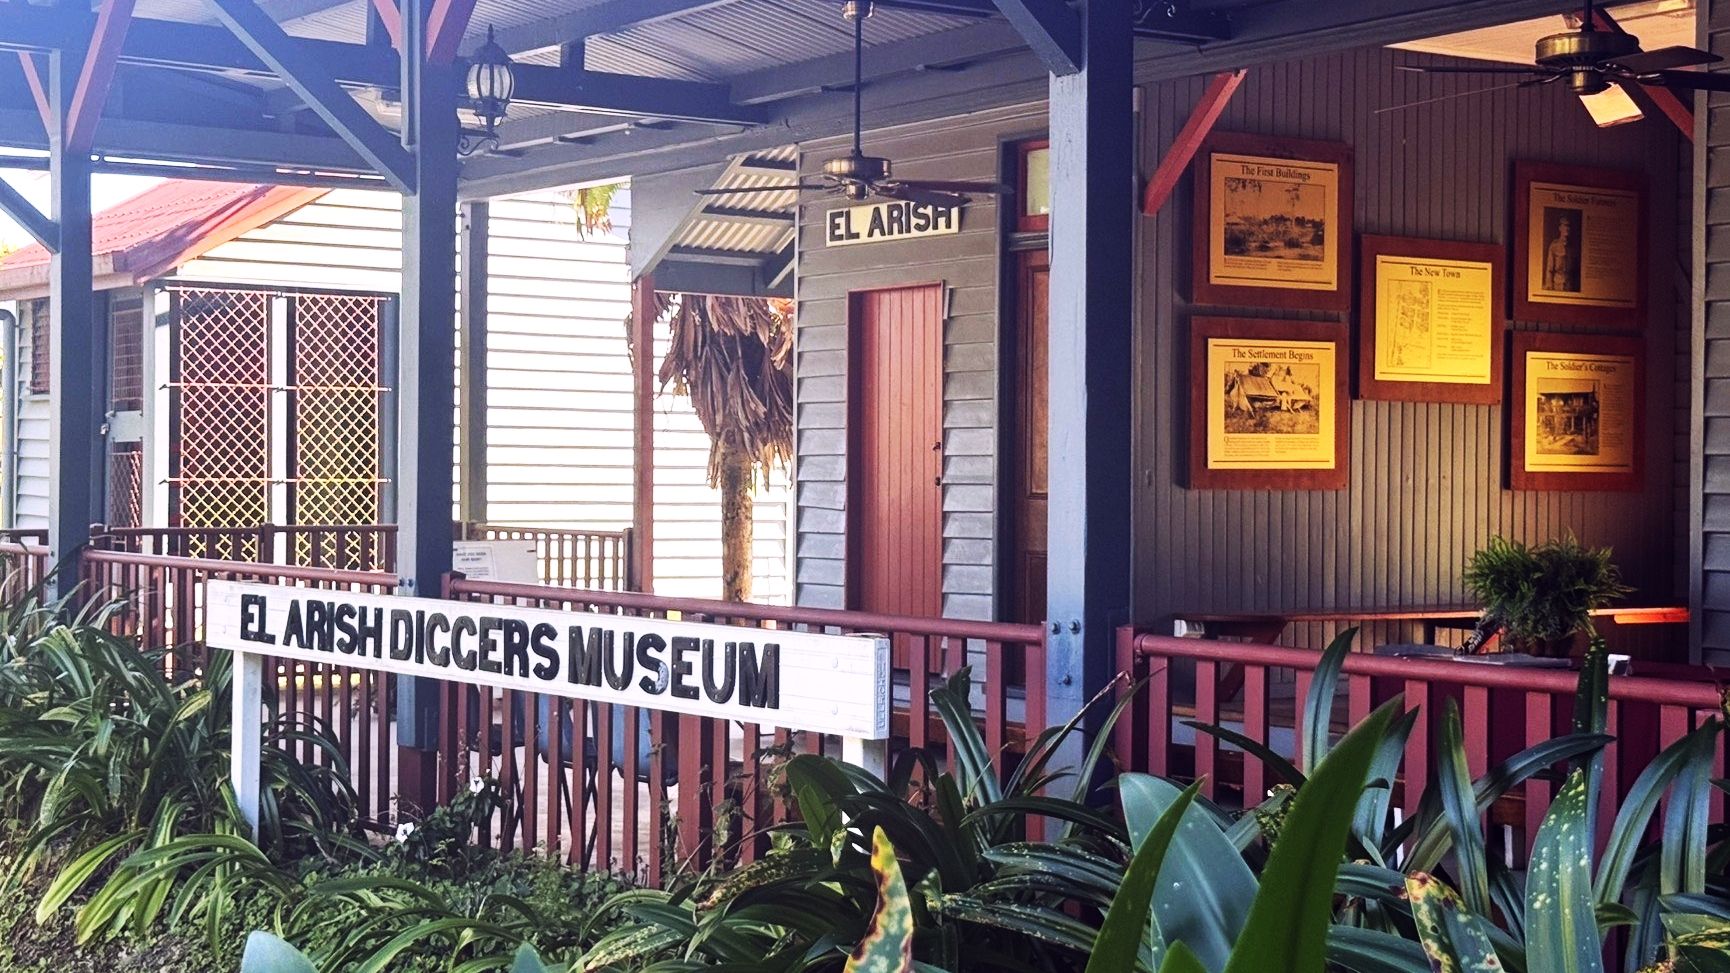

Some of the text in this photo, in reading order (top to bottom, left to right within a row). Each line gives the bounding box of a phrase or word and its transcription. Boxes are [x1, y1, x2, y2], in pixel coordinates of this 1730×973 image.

[1241, 165, 1311, 182] The First Buildings
[829, 201, 952, 242] EL ARISH
[1410, 266, 1461, 278] The New Town
[1232, 348, 1314, 361] The Settlement Begins
[1546, 361, 1559, 370] The
[240, 594, 780, 709] EL ARISH DIGGERS MUSEUM
